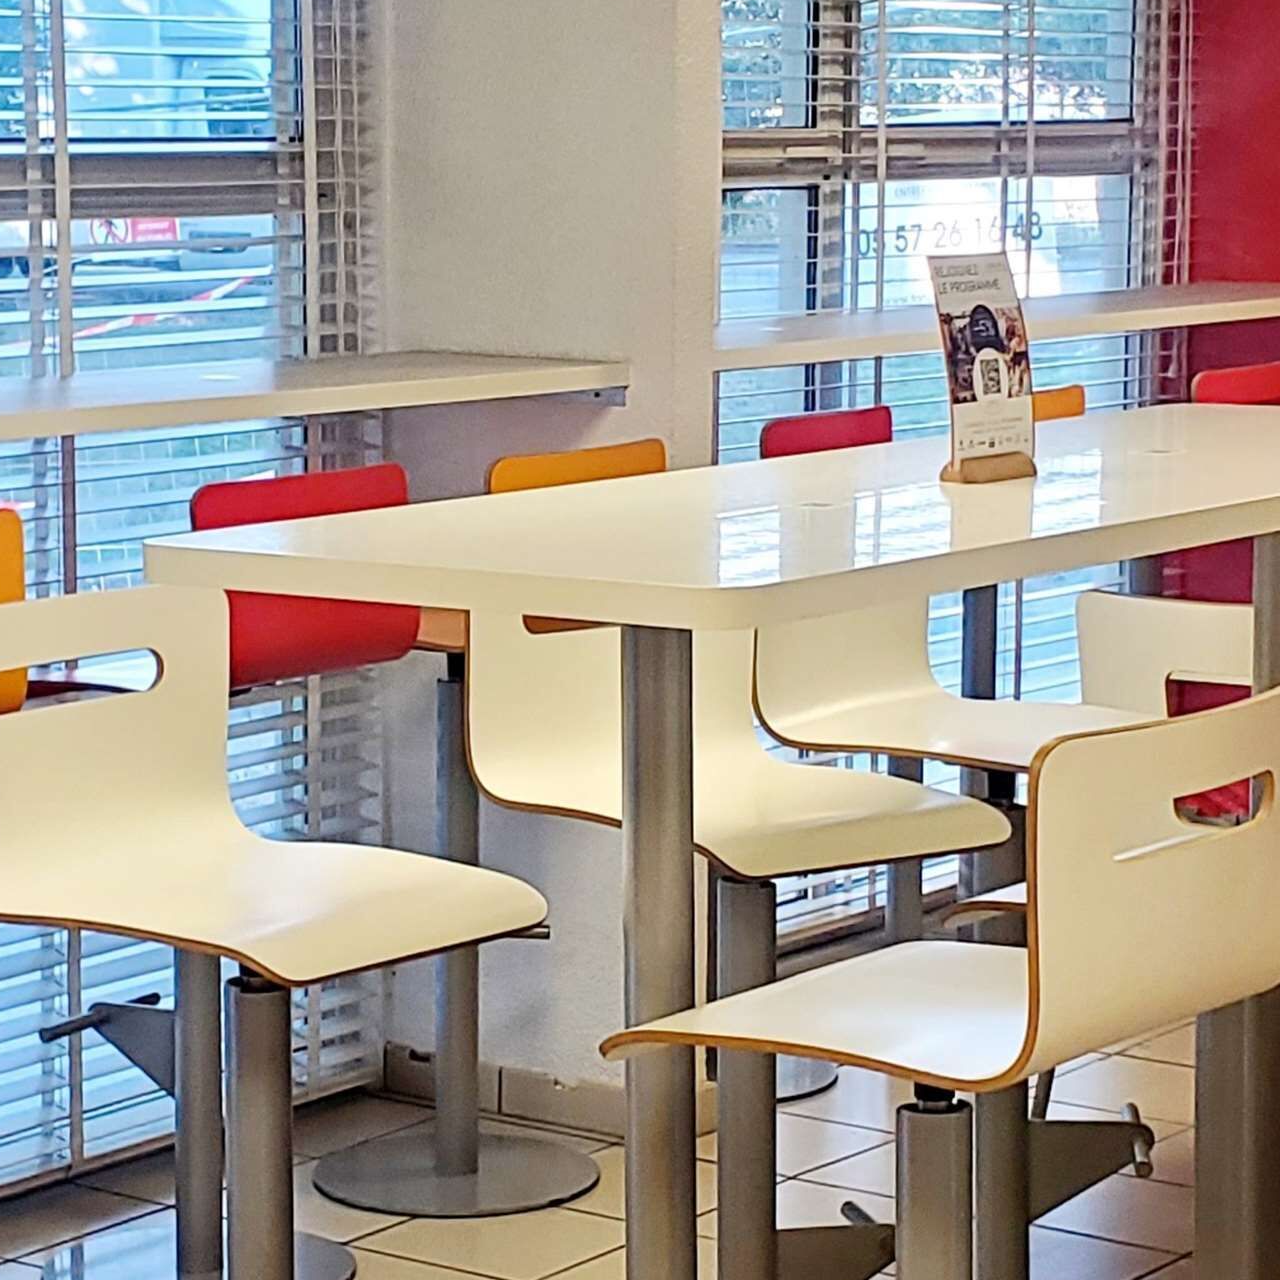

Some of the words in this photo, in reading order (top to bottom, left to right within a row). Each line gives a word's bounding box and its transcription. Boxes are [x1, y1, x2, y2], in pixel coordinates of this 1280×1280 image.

[895, 223, 922, 254] 57
[933, 219, 962, 250] 26
[975, 216, 1004, 244] 16
[1012, 211, 1042, 241] 48
